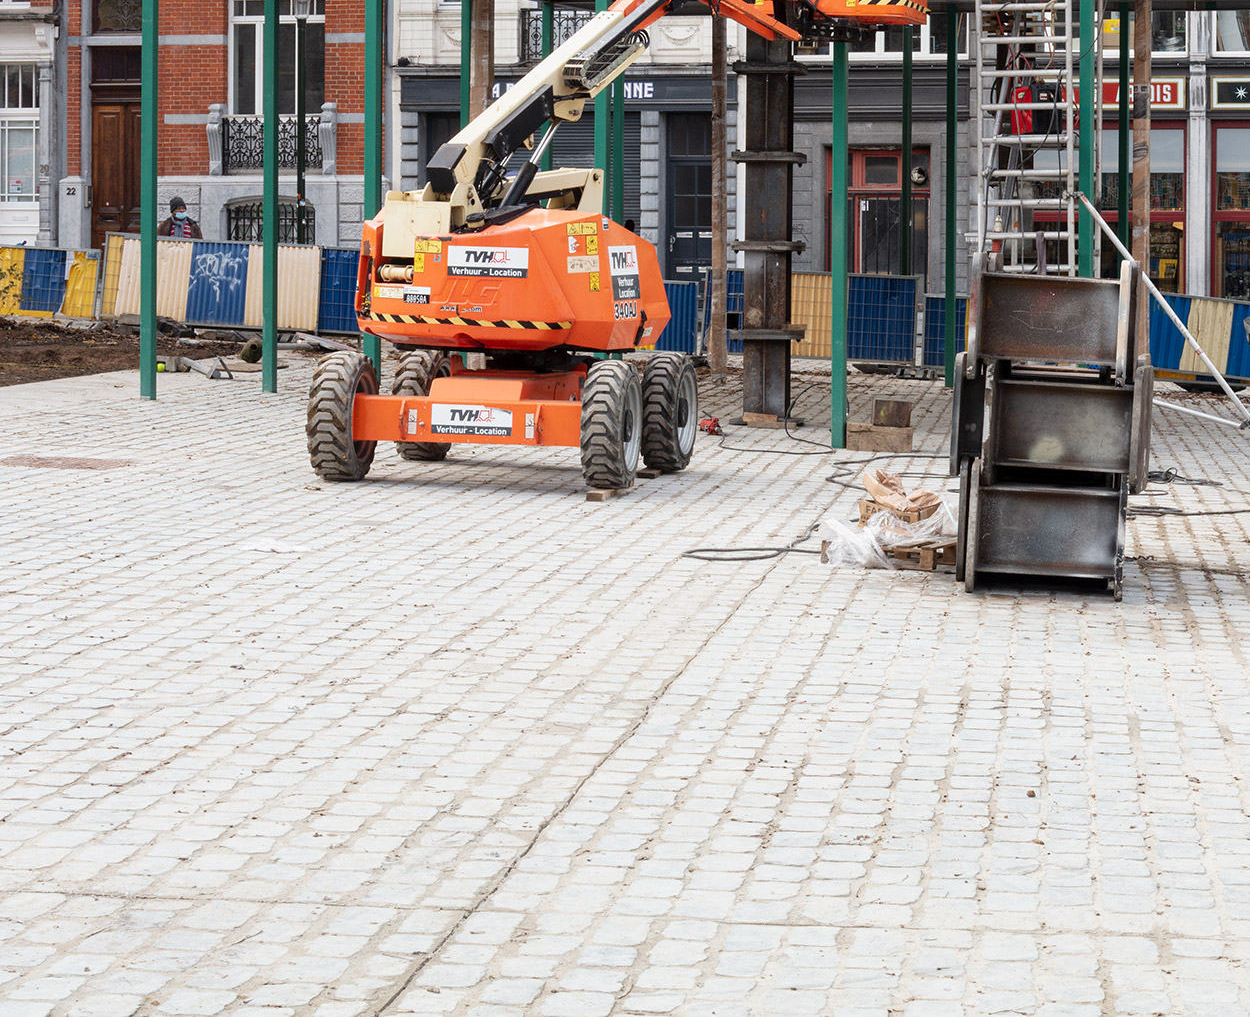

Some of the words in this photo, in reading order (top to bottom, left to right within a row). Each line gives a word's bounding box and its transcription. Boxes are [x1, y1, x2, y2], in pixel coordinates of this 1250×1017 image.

[66, 187, 76, 195] 22
[465, 250, 494, 263] TVH
[611, 252, 626, 269] TVH
[452, 267, 482, 276] Verhuur
[489, 268, 522, 277] Location
[617, 276, 634, 286] Verhuur
[618, 287, 636, 299] Location
[614, 301, 637, 320] 340AJ
[450, 409, 479, 422] TVH
[436, 425, 467, 434] Verhuur
[475, 427, 507, 436] Location
